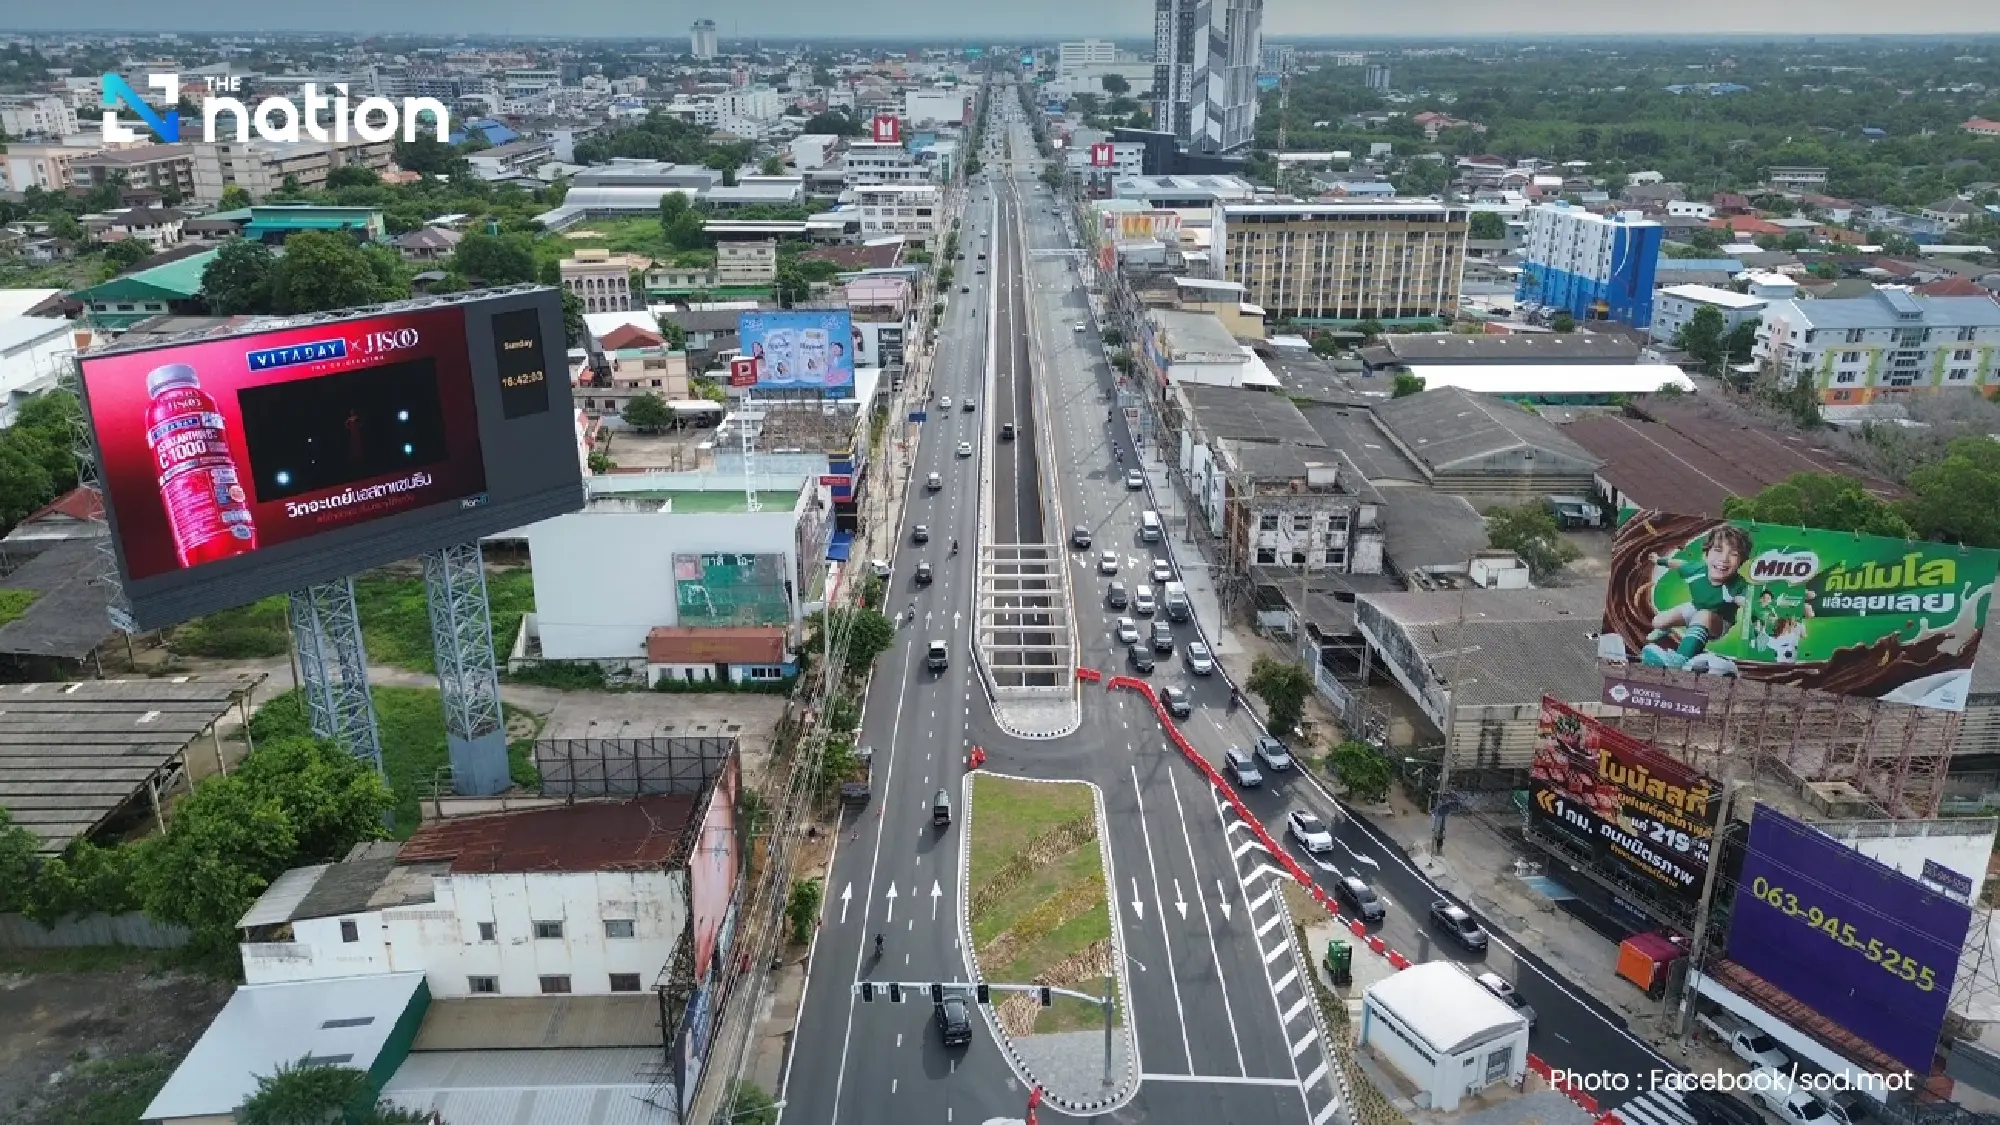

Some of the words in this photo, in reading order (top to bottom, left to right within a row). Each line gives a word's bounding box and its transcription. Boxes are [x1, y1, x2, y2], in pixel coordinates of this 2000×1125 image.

[256, 342, 337, 366] VITADAY
[504, 339, 532, 349] Sunday
[170, 440, 206, 462] 1000
[1753, 559, 1812, 577] MILO
[1825, 552, 1956, 592] ดื่มไมโล
[1822, 592, 1955, 616] แล้วลุยเลย
[1555, 800, 1563, 817] 1
[1600, 824, 1695, 886] ถนนมิตรภาพ
[1649, 821, 1690, 852] 219
[1753, 876, 1936, 992] 063-945-5255
